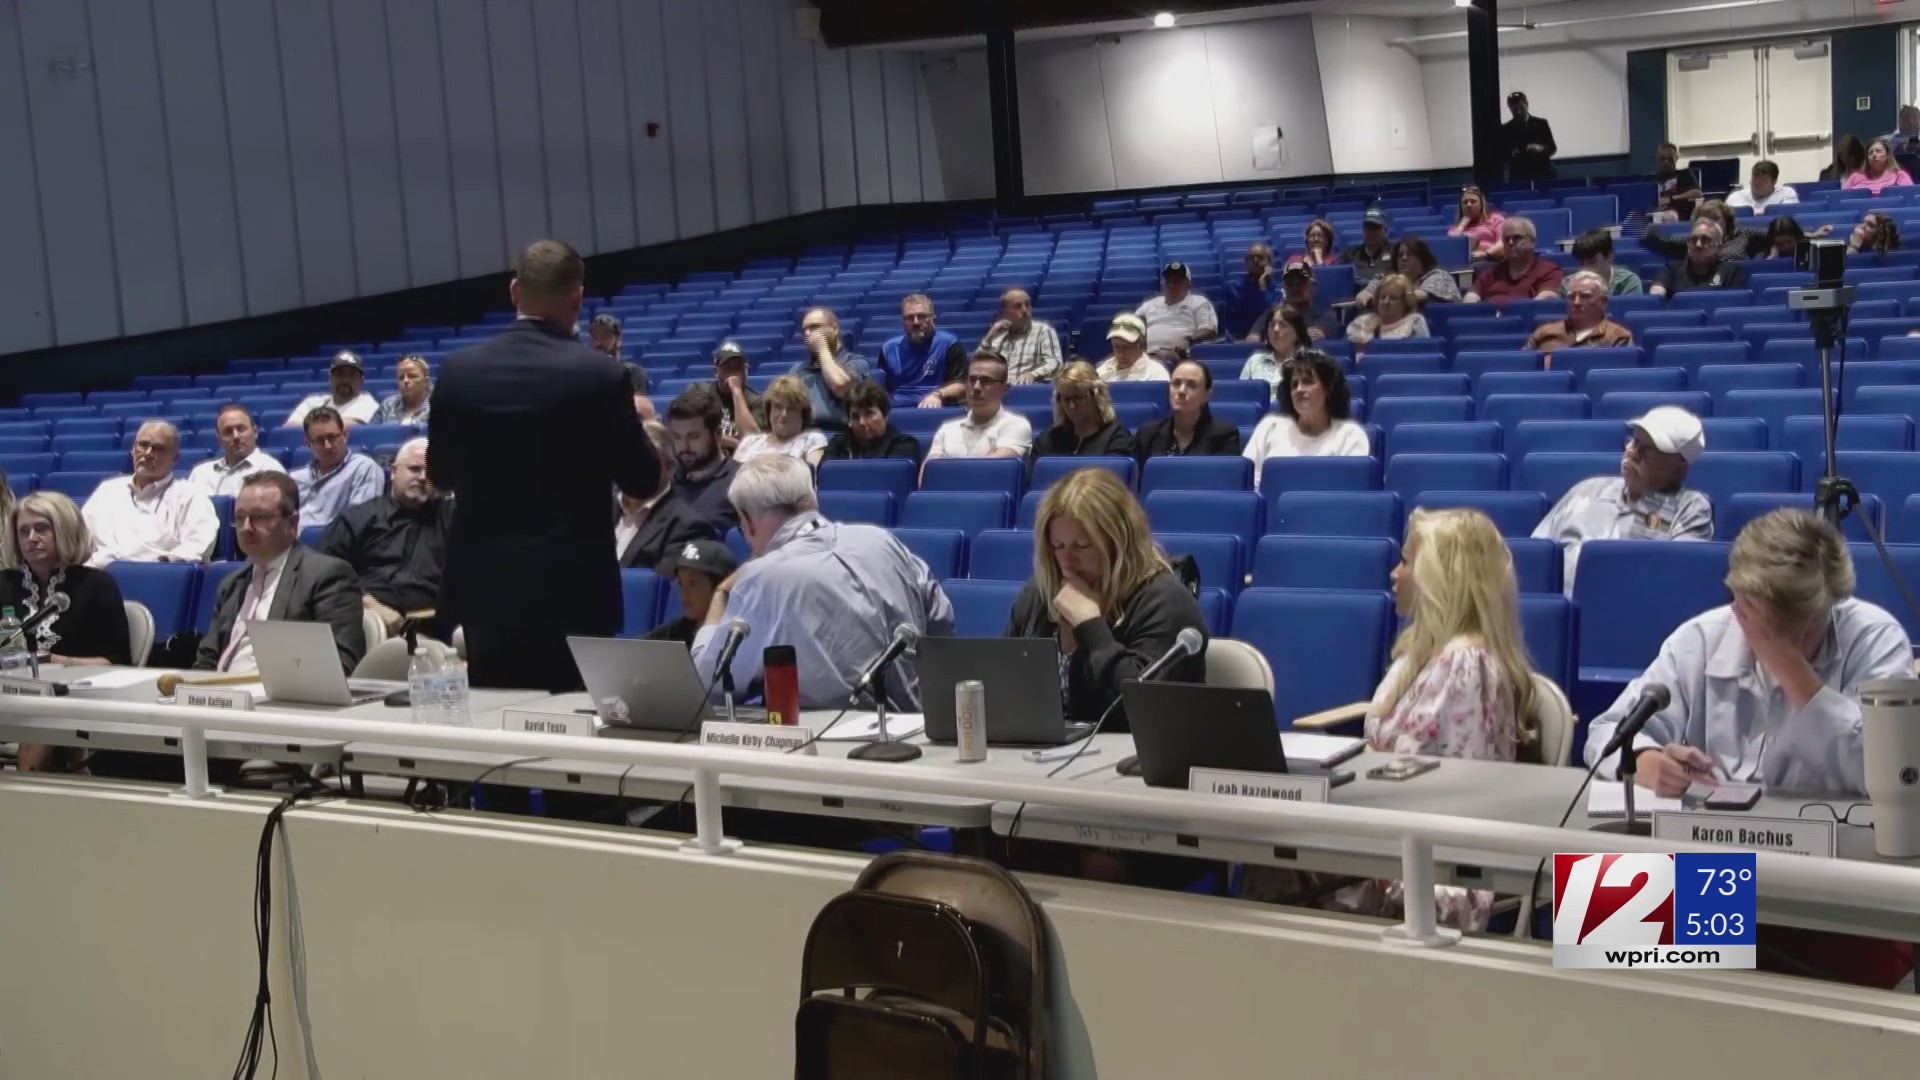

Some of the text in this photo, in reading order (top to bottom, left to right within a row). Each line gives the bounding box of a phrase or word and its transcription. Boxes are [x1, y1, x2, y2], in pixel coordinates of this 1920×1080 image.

[525, 719, 545, 732] David
[706, 732, 740, 746] Michelle
[1212, 781, 1302, 801] Leah Hazelwood
[1692, 825, 1793, 847] Karen Bachus
